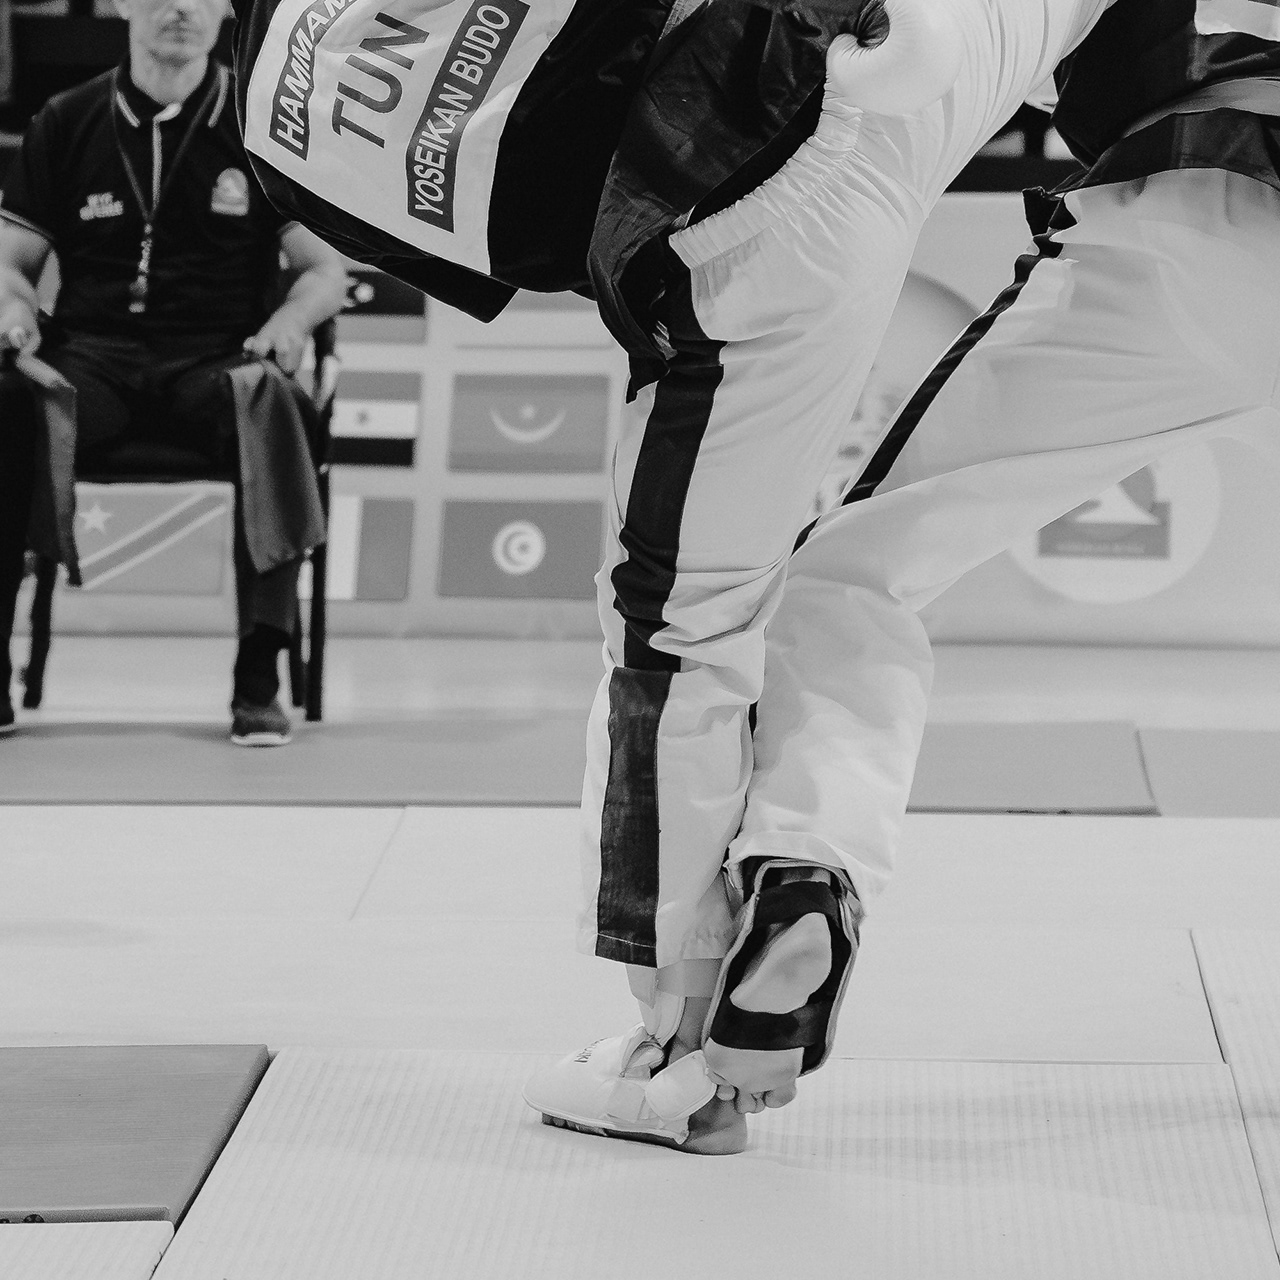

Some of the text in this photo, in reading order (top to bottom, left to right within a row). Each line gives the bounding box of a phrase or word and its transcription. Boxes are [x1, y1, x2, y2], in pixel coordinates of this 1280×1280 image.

[331, 10, 430, 150] TUN
[413, 4, 511, 216] YOSEIKAN BUDO
